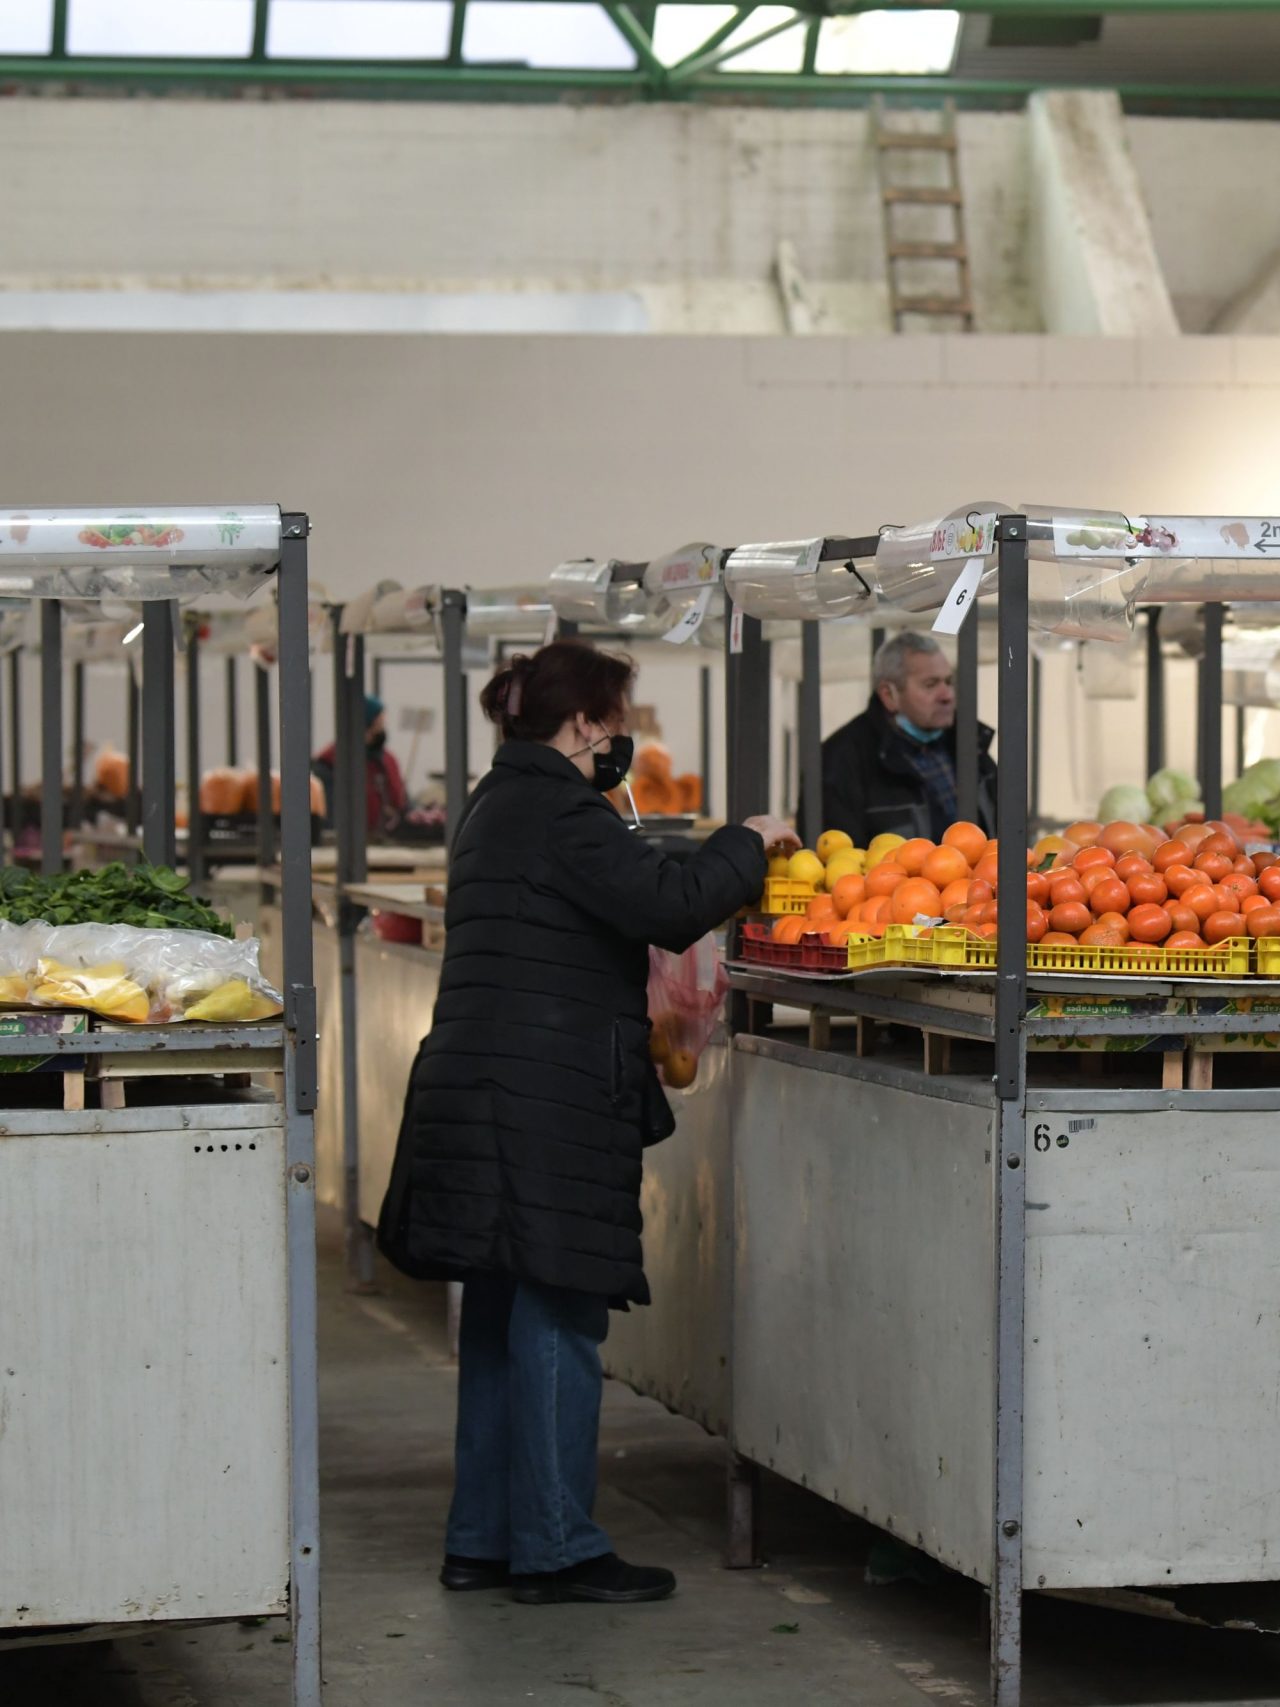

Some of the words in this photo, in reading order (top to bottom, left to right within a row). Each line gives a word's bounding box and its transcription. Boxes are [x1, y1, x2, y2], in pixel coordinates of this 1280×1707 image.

[956, 589, 967, 605] 6
[1102, 1006, 1128, 1014] Fresh
[1034, 1124, 1050, 1152] 6
